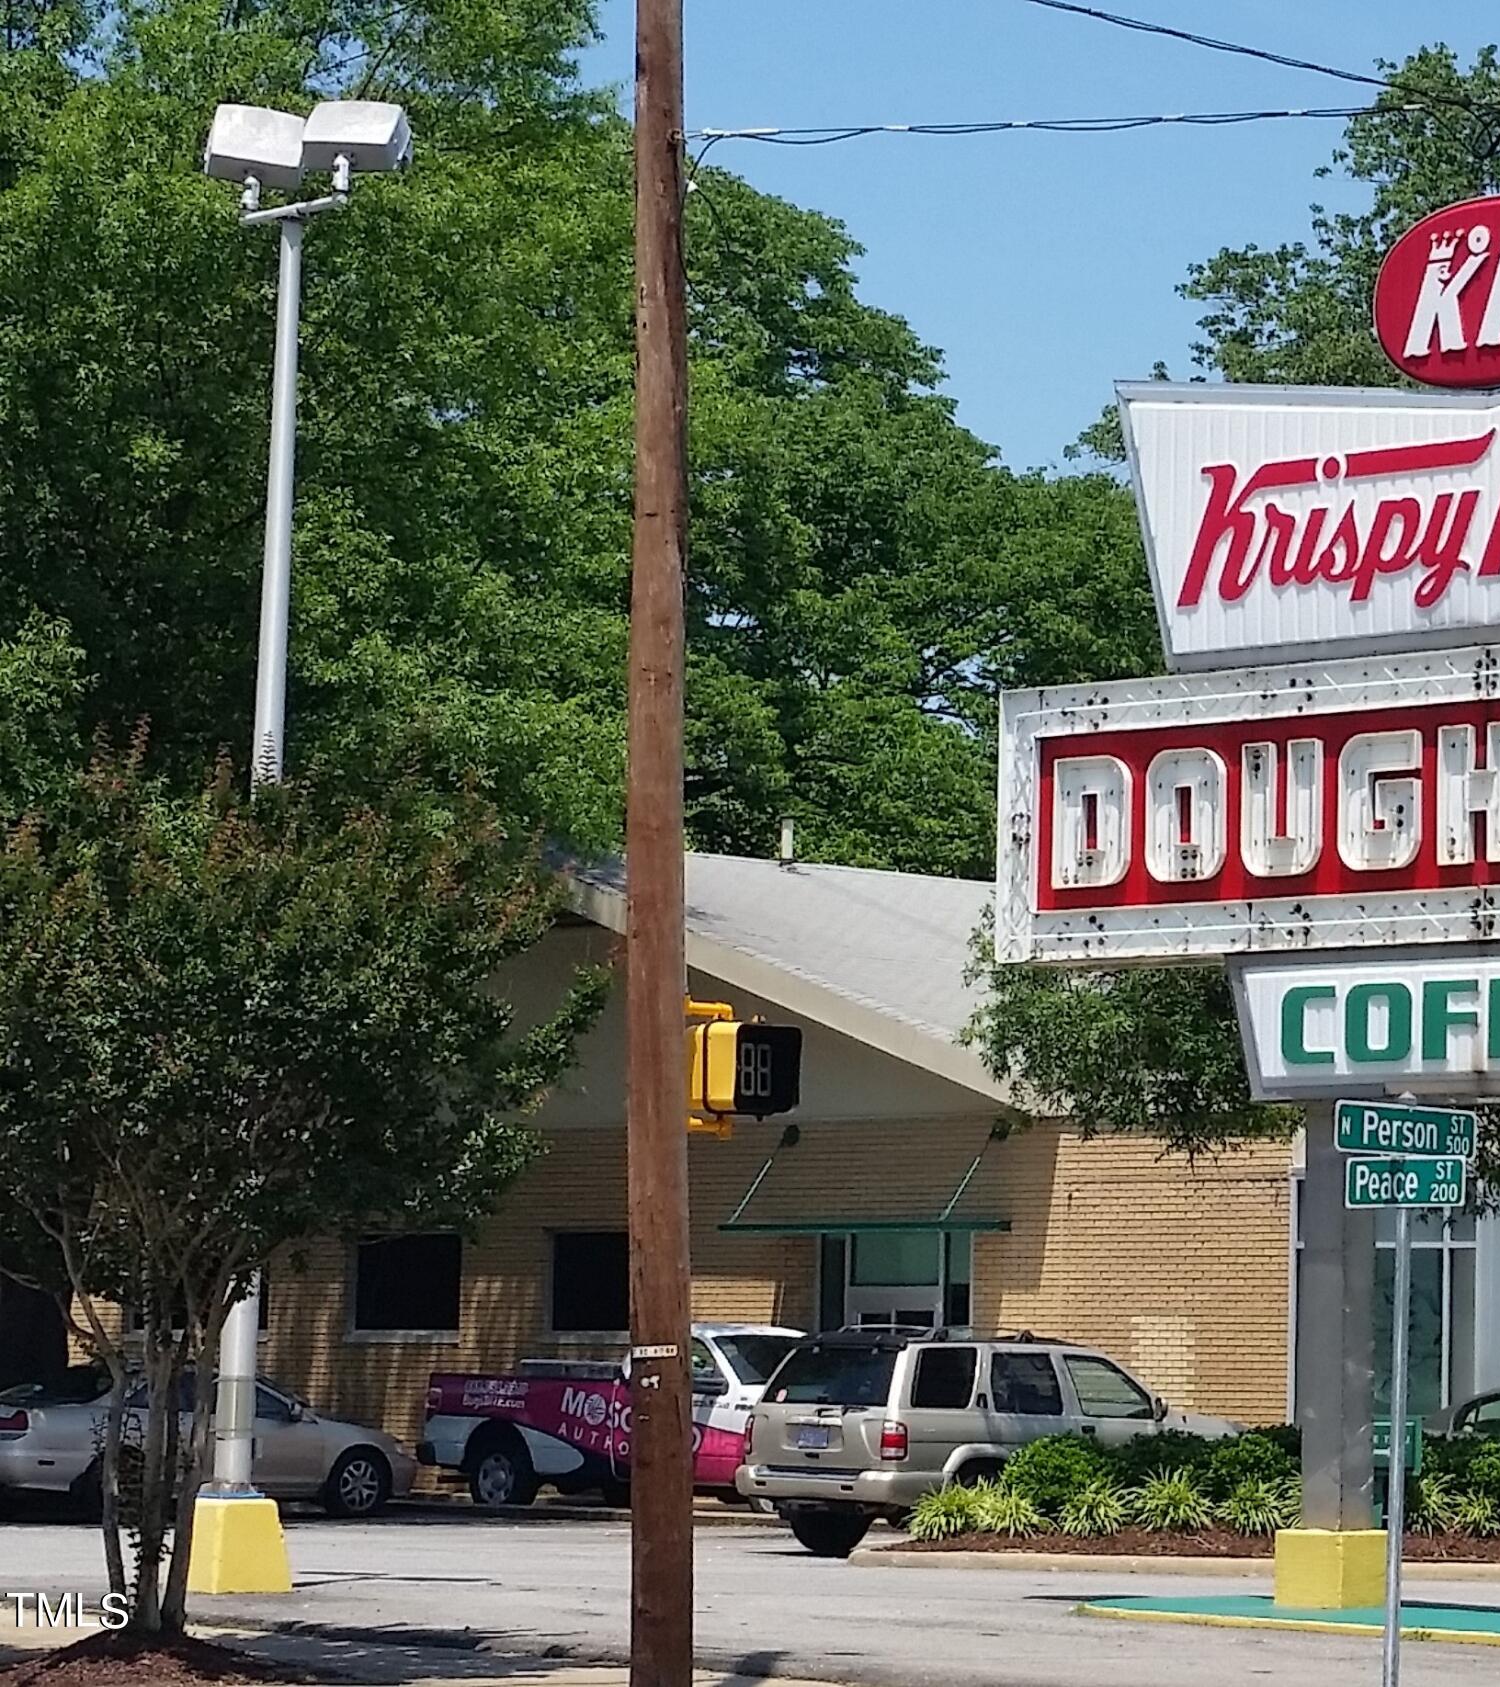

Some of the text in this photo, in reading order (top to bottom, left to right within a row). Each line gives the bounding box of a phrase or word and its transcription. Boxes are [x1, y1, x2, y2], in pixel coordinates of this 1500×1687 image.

[1176, 426, 1498, 608] Krispy
[1341, 1110, 1467, 1151] N Person ST
[1445, 1135, 1470, 1155] 500
[1355, 1161, 1454, 1200] Peace ST
[1429, 1182, 1458, 1202] 200
